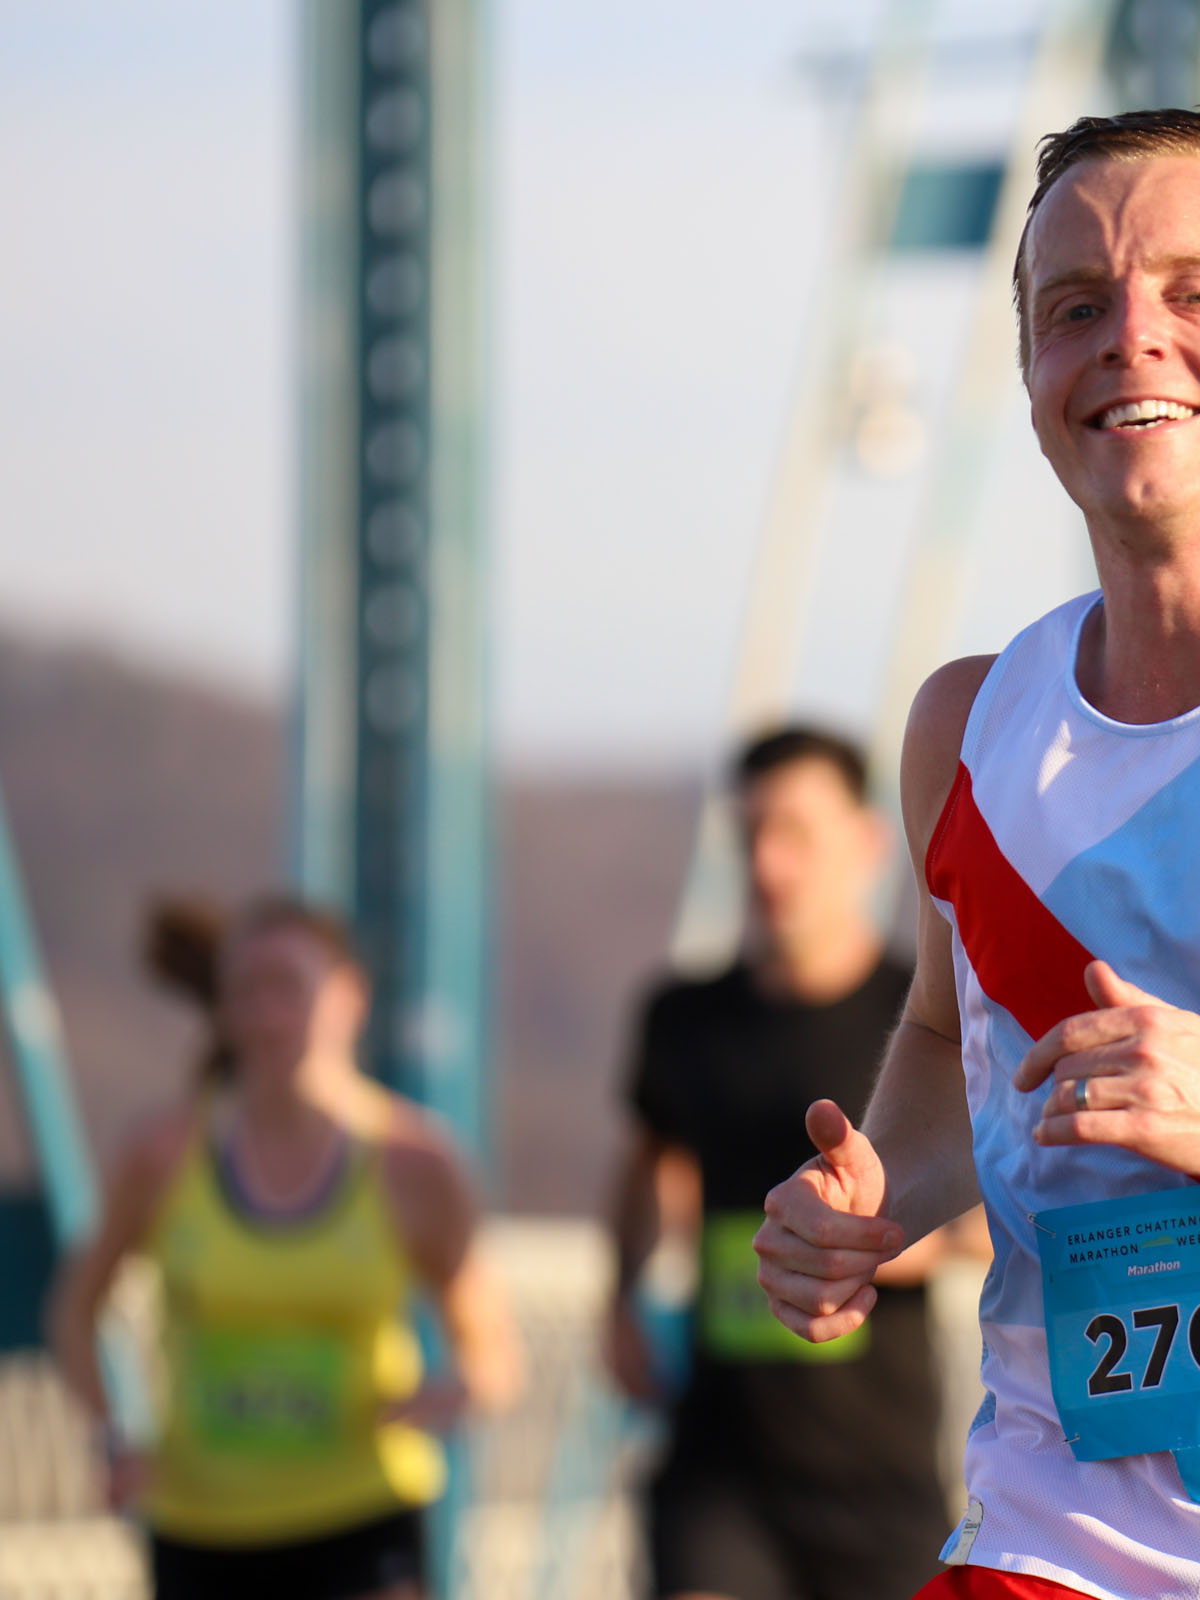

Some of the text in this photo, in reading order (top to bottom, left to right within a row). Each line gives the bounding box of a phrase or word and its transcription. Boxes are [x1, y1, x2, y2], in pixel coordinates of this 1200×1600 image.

[1067, 1226, 1131, 1246] ERLANGER
[1069, 1243, 1139, 1265] MARATHON
[1127, 1260, 1181, 1277] Marathon
